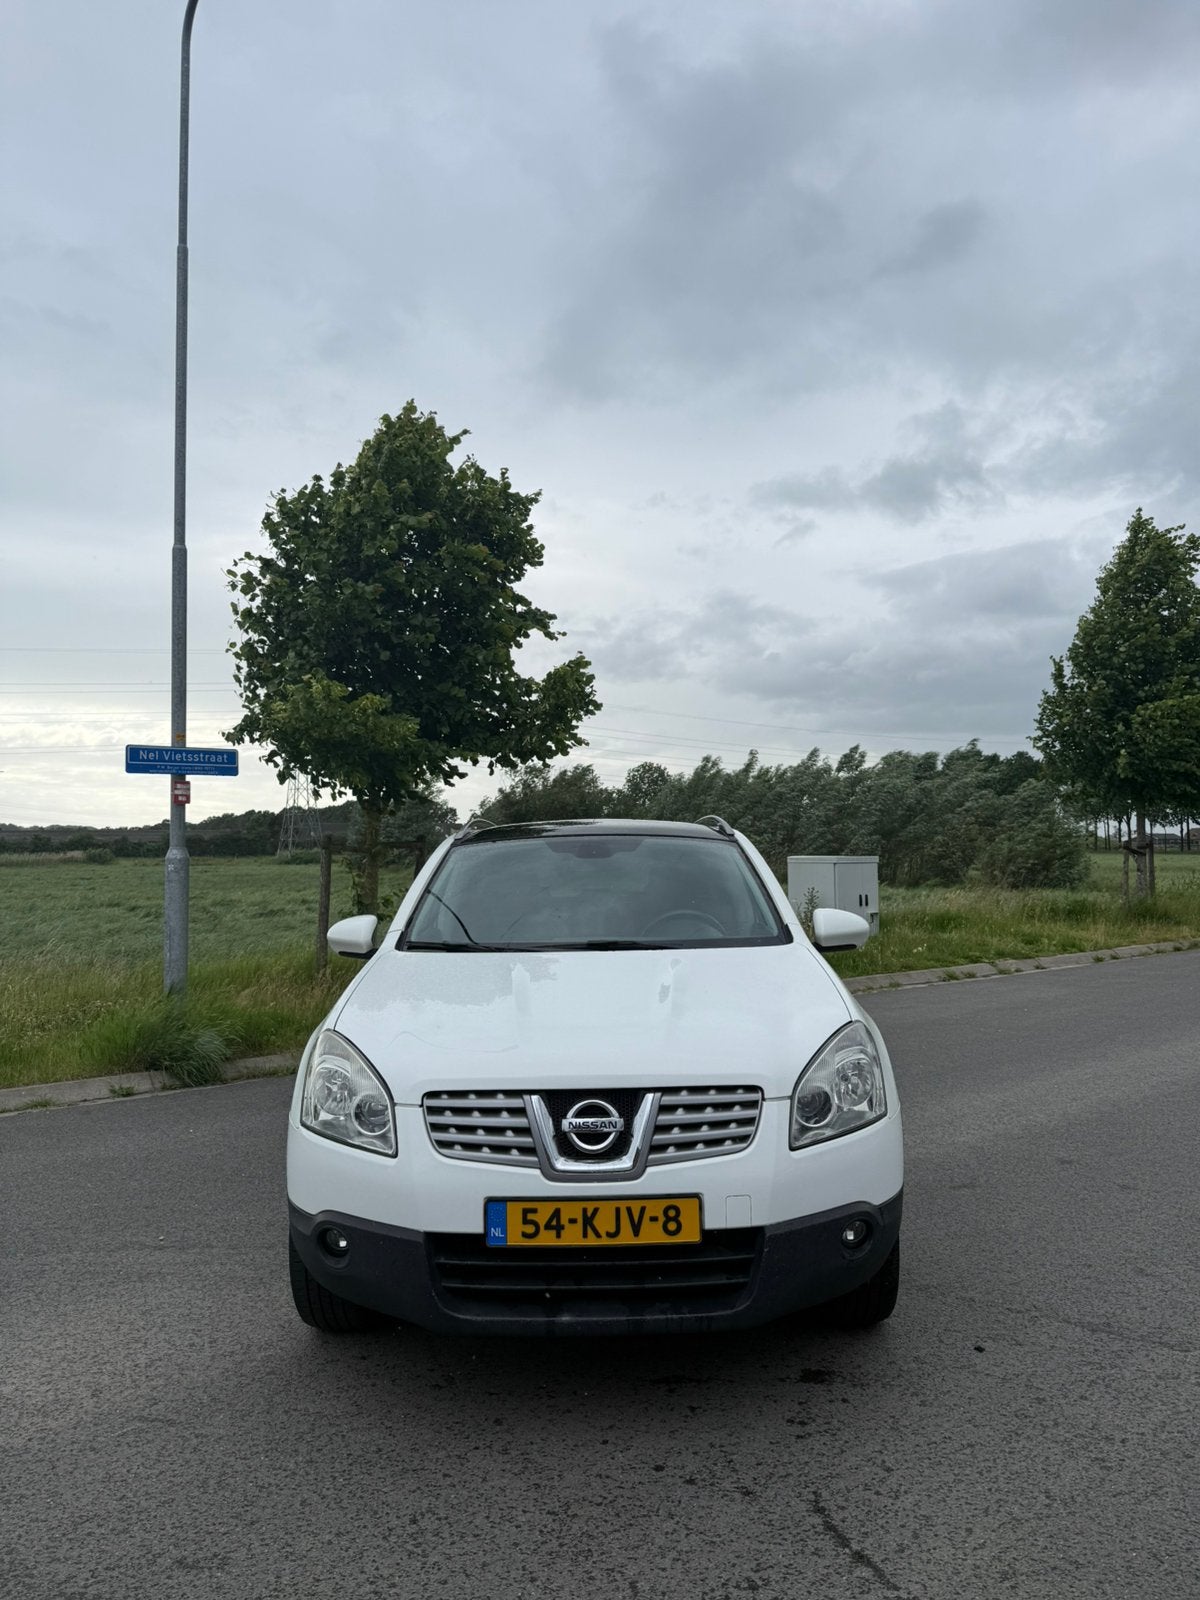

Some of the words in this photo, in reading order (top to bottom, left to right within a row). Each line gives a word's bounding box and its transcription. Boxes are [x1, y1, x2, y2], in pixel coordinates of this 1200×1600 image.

[139, 750, 159, 761] Nel
[163, 751, 228, 763] Vietsstraat
[568, 1121, 618, 1130] NISSAN
[521, 1204, 683, 1240] 54-KJV-8
[490, 1227, 505, 1238] NL
